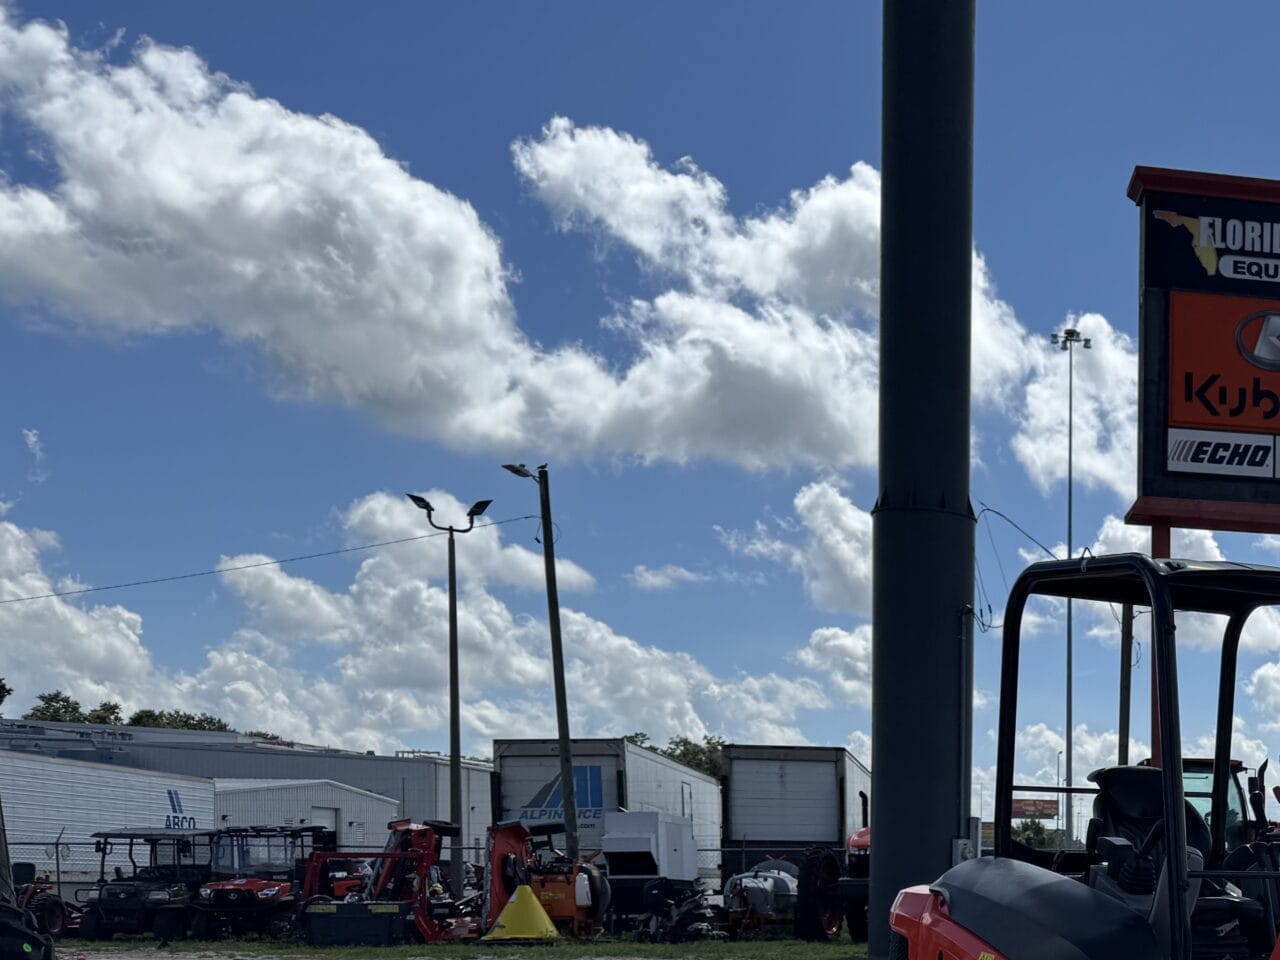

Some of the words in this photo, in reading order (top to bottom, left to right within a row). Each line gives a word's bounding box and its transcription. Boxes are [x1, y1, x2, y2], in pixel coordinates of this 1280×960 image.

[1190, 441, 1272, 467] ECHO
[519, 809, 566, 820] ALPIN
[577, 809, 603, 819] ICE
